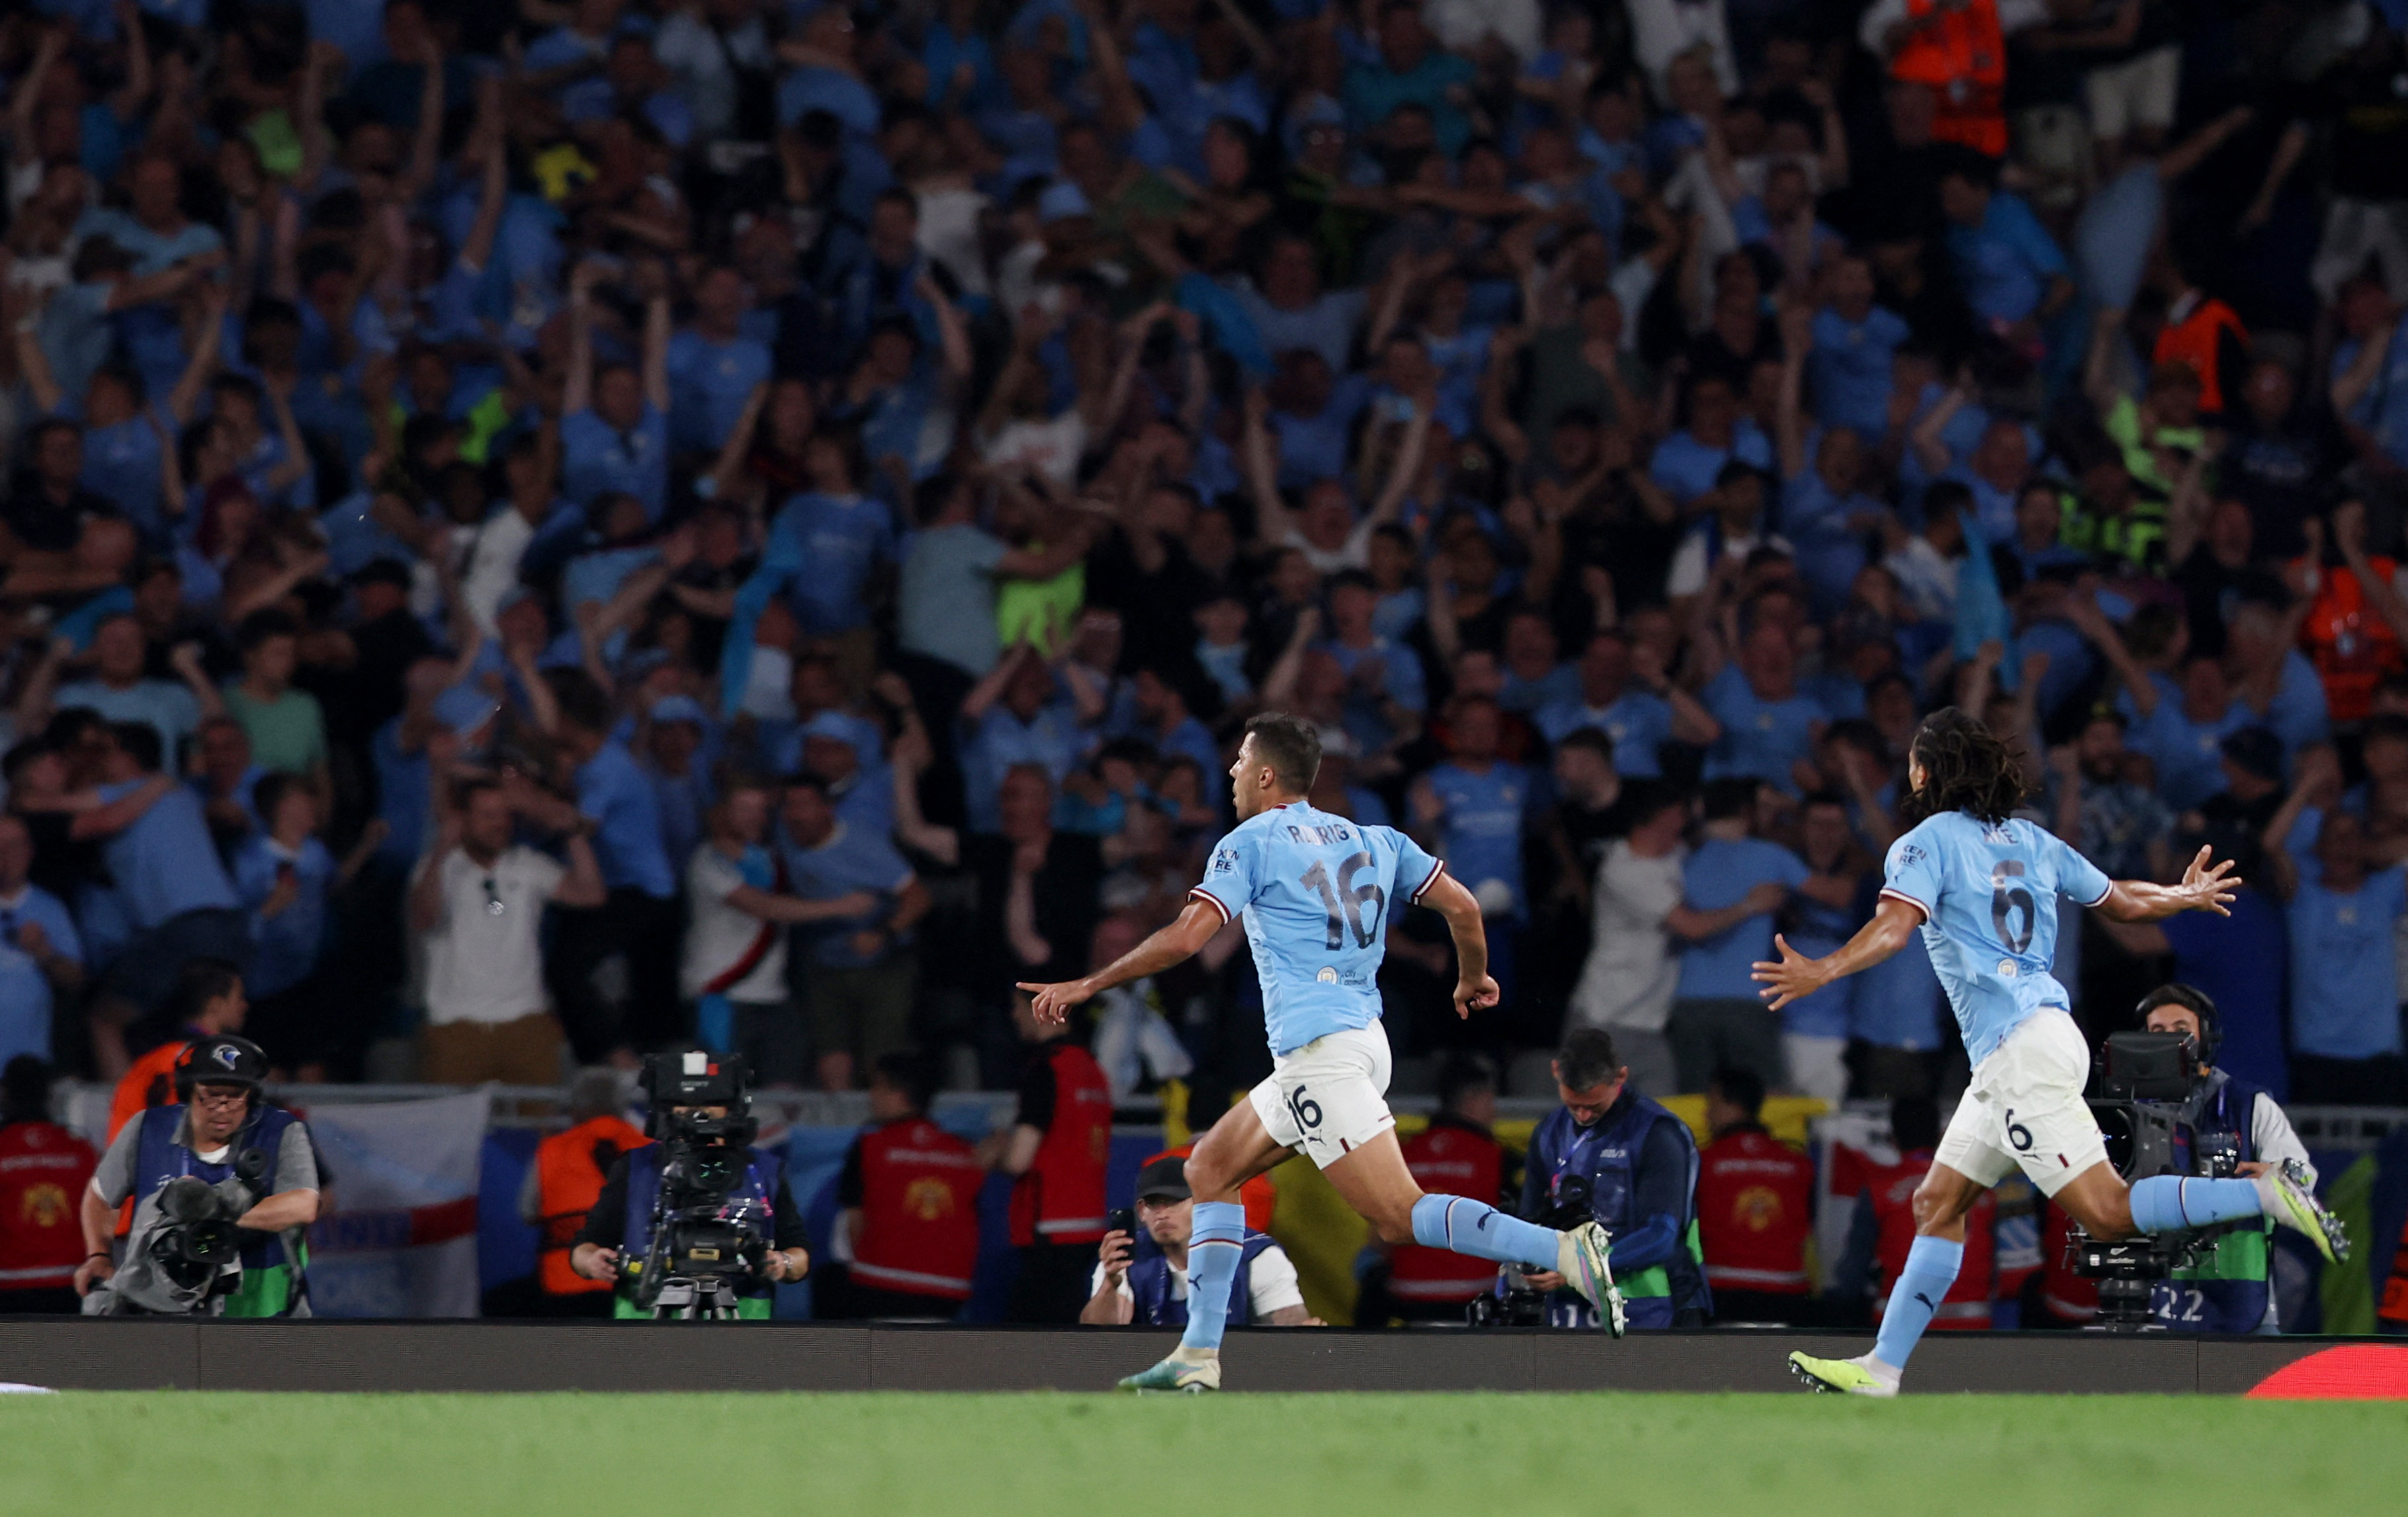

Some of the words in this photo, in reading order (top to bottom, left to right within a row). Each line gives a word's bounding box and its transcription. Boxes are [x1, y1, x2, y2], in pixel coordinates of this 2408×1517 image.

[1286, 823, 1359, 845] RRIG
[1299, 851, 1384, 951] 16
[1991, 859, 2035, 955] 6
[1285, 1084, 1322, 1136] 16
[2005, 1108, 2033, 1151] 6
